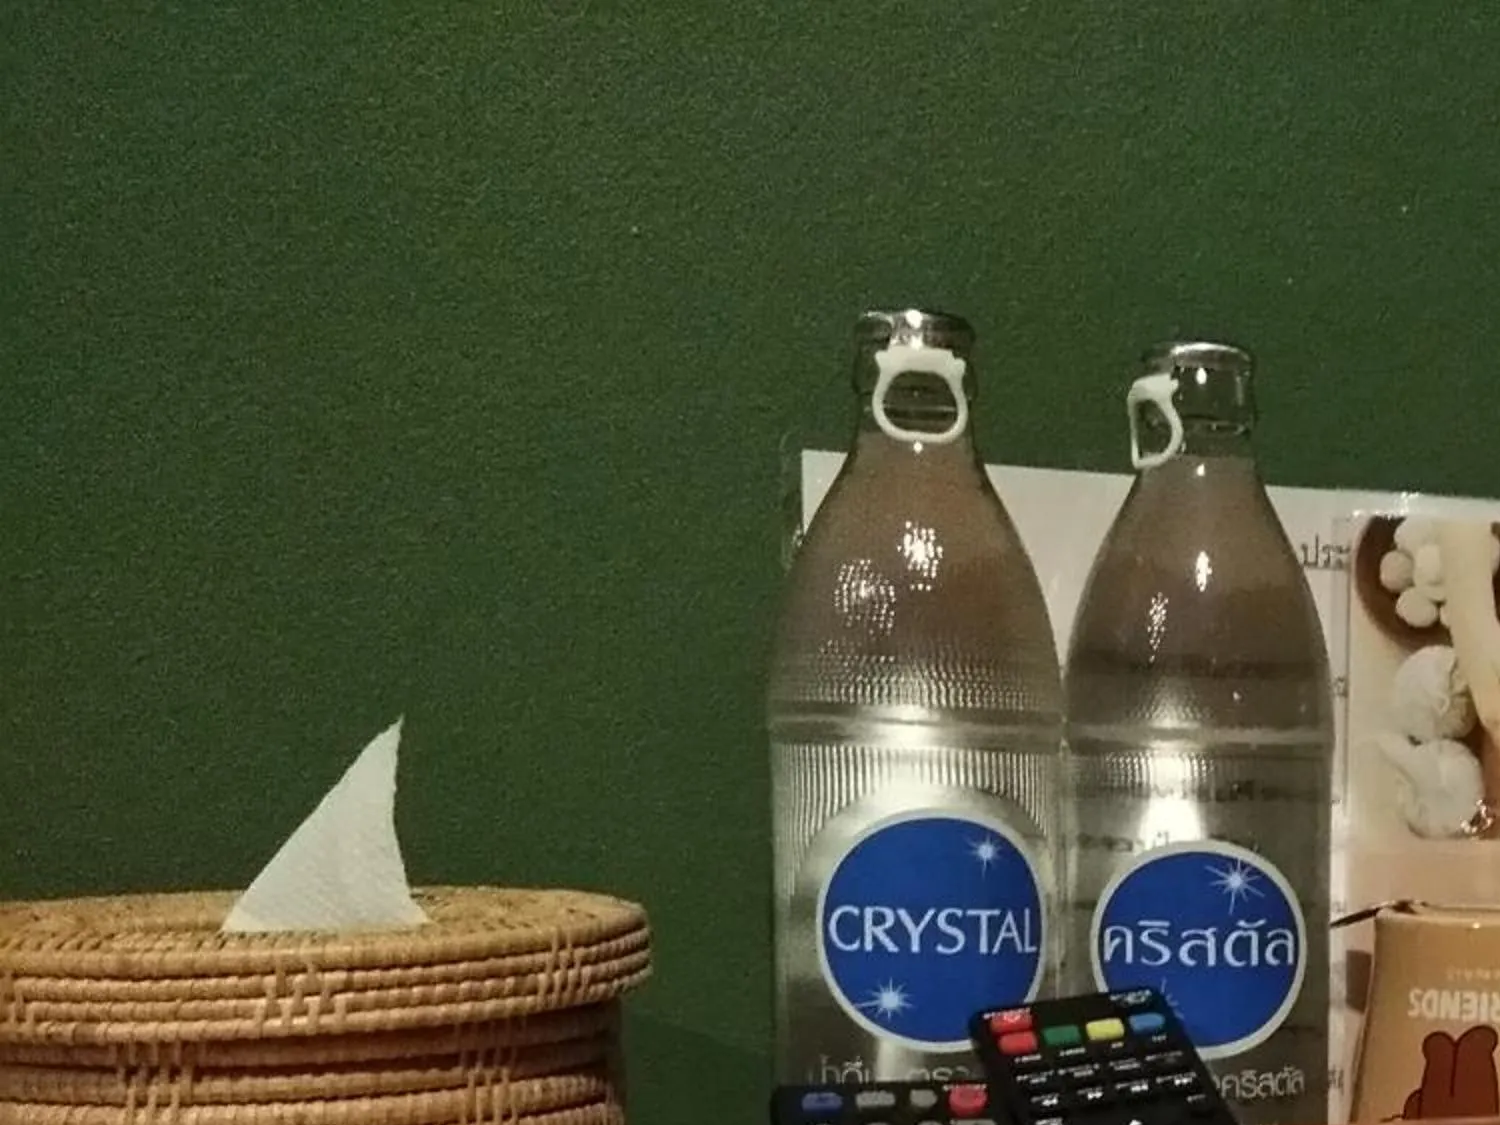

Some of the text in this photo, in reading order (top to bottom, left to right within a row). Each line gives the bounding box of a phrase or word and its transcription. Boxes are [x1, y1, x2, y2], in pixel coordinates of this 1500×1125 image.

[828, 905, 1038, 955] CRYSTAL
[1103, 919, 1296, 968] คริสตัล
